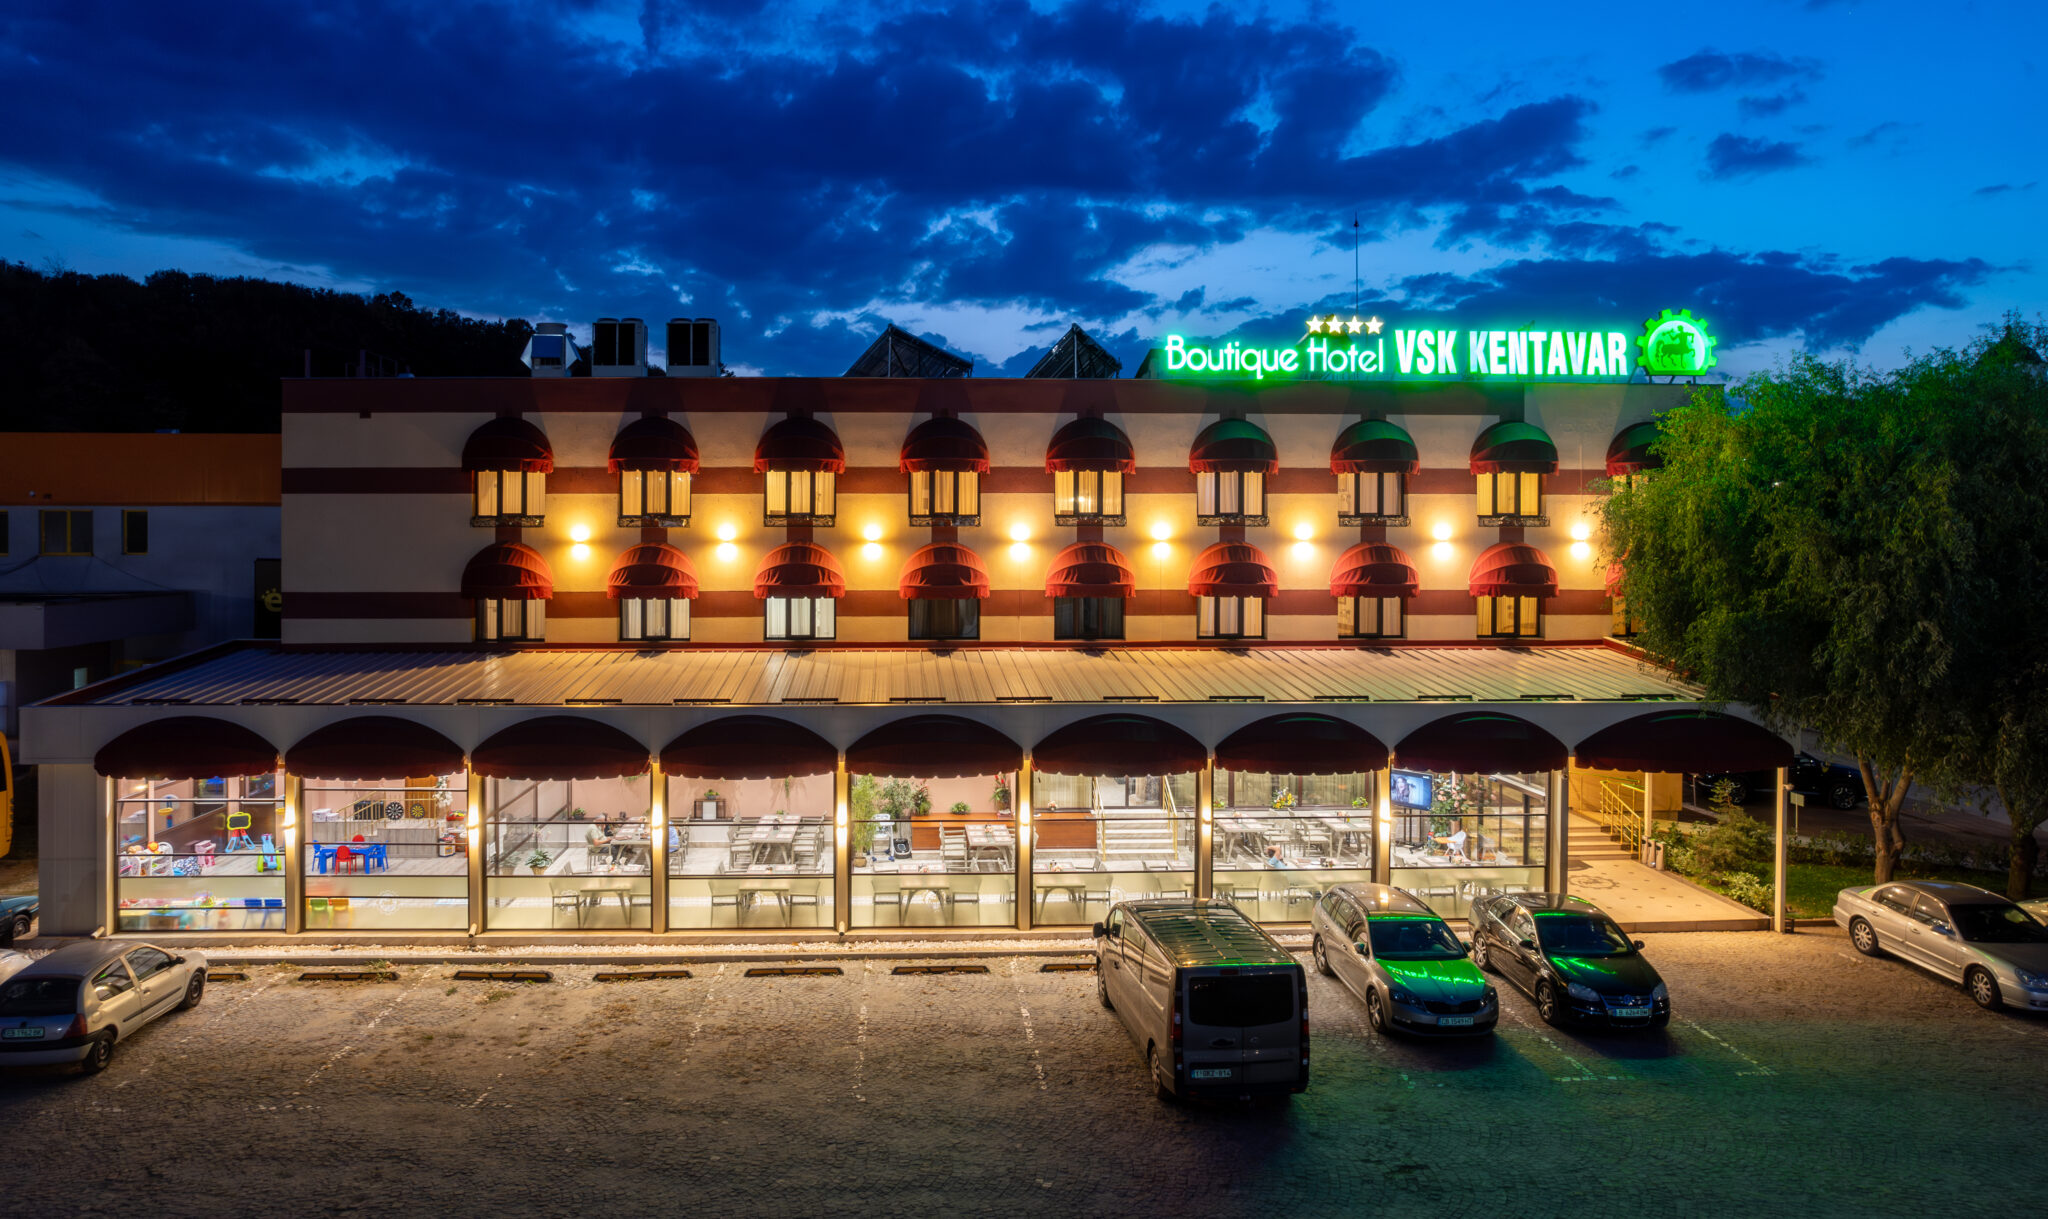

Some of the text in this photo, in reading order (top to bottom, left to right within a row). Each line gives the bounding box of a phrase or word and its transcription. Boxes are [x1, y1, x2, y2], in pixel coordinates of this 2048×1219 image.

[1165, 329, 1628, 380] Boutique Hotel VSK KENTAVAR
